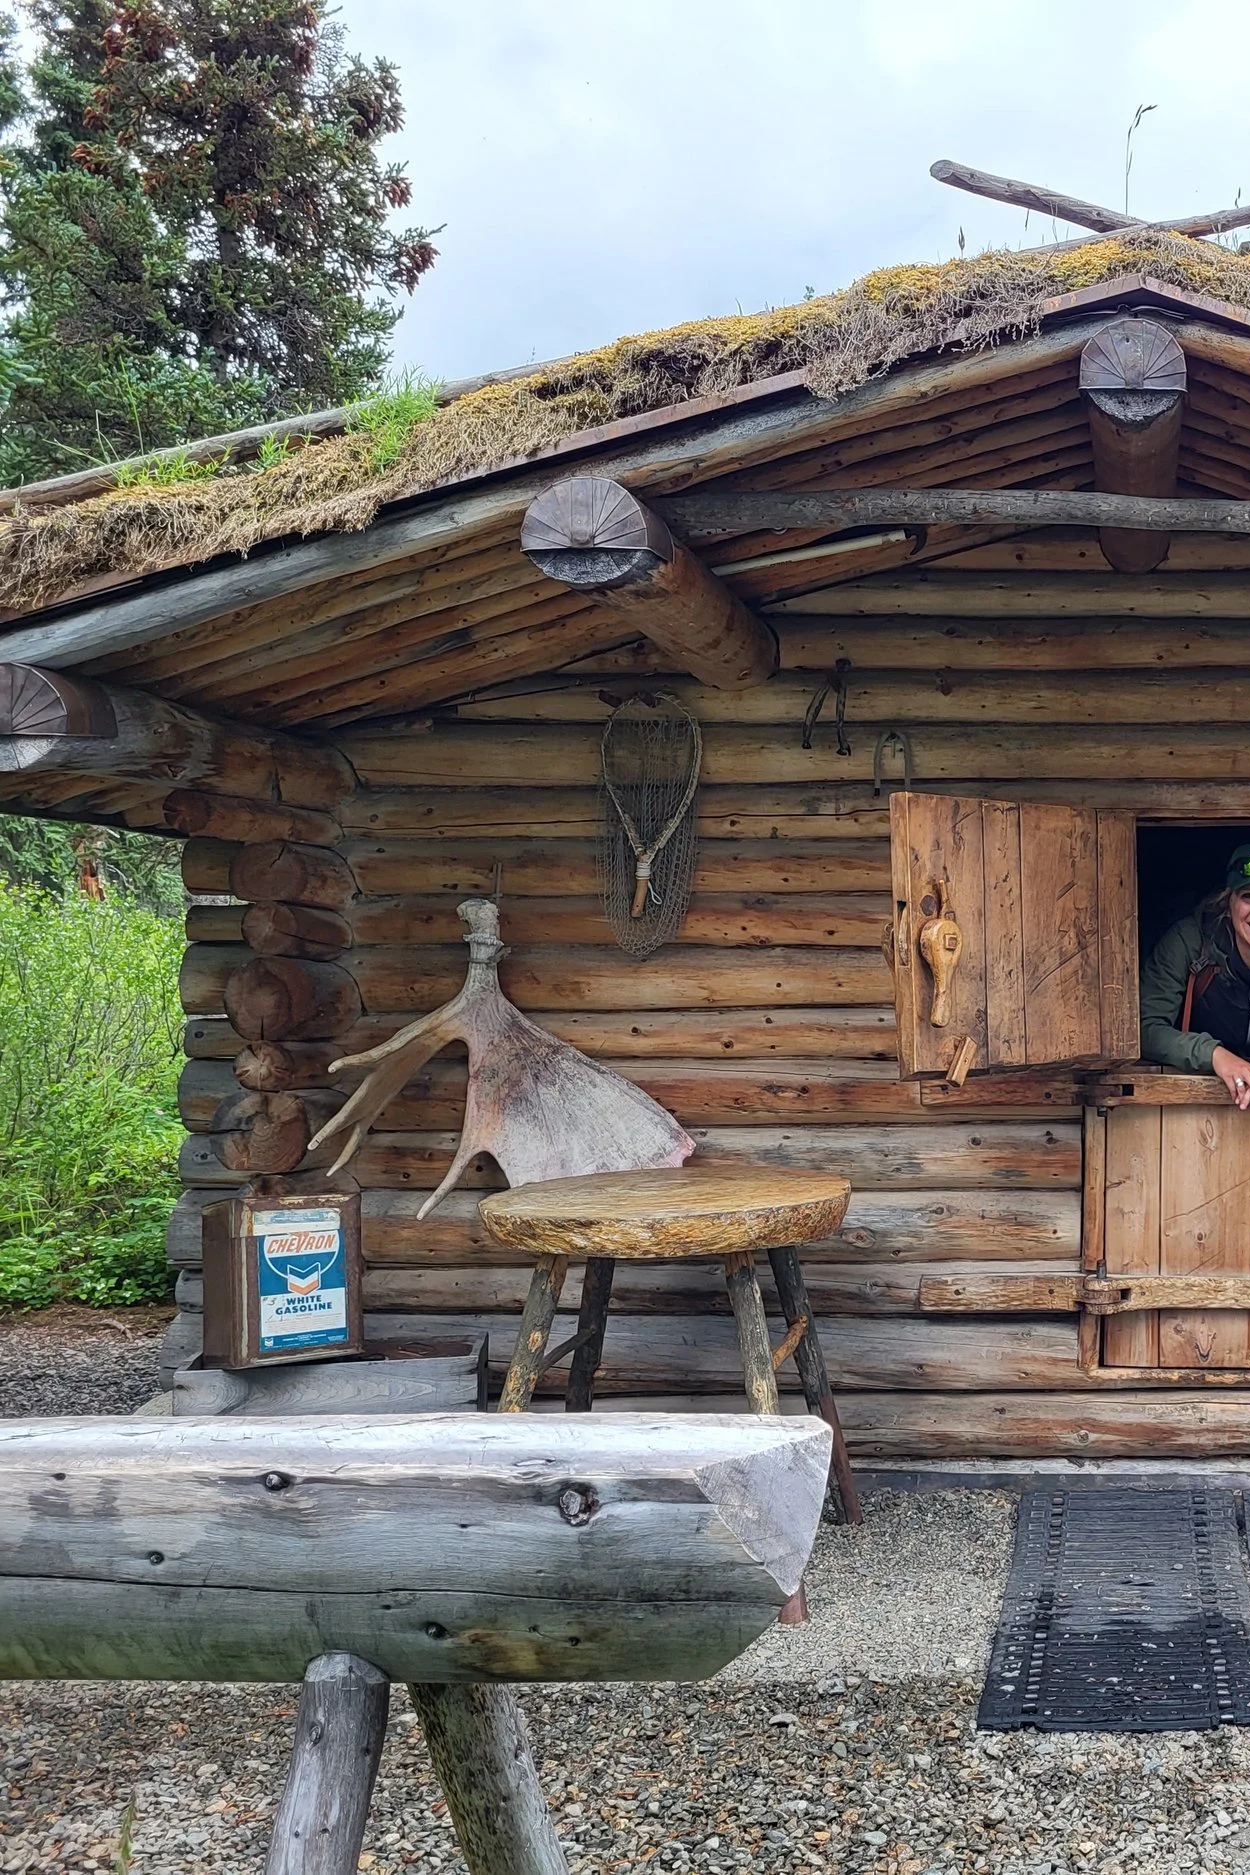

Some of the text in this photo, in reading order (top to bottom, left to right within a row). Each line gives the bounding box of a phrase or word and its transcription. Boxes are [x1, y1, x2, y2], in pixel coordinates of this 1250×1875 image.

[267, 1231, 336, 1254] CHEVRON
[286, 1295, 322, 1306] WHITE
[275, 1302, 333, 1315] GASOLINE
